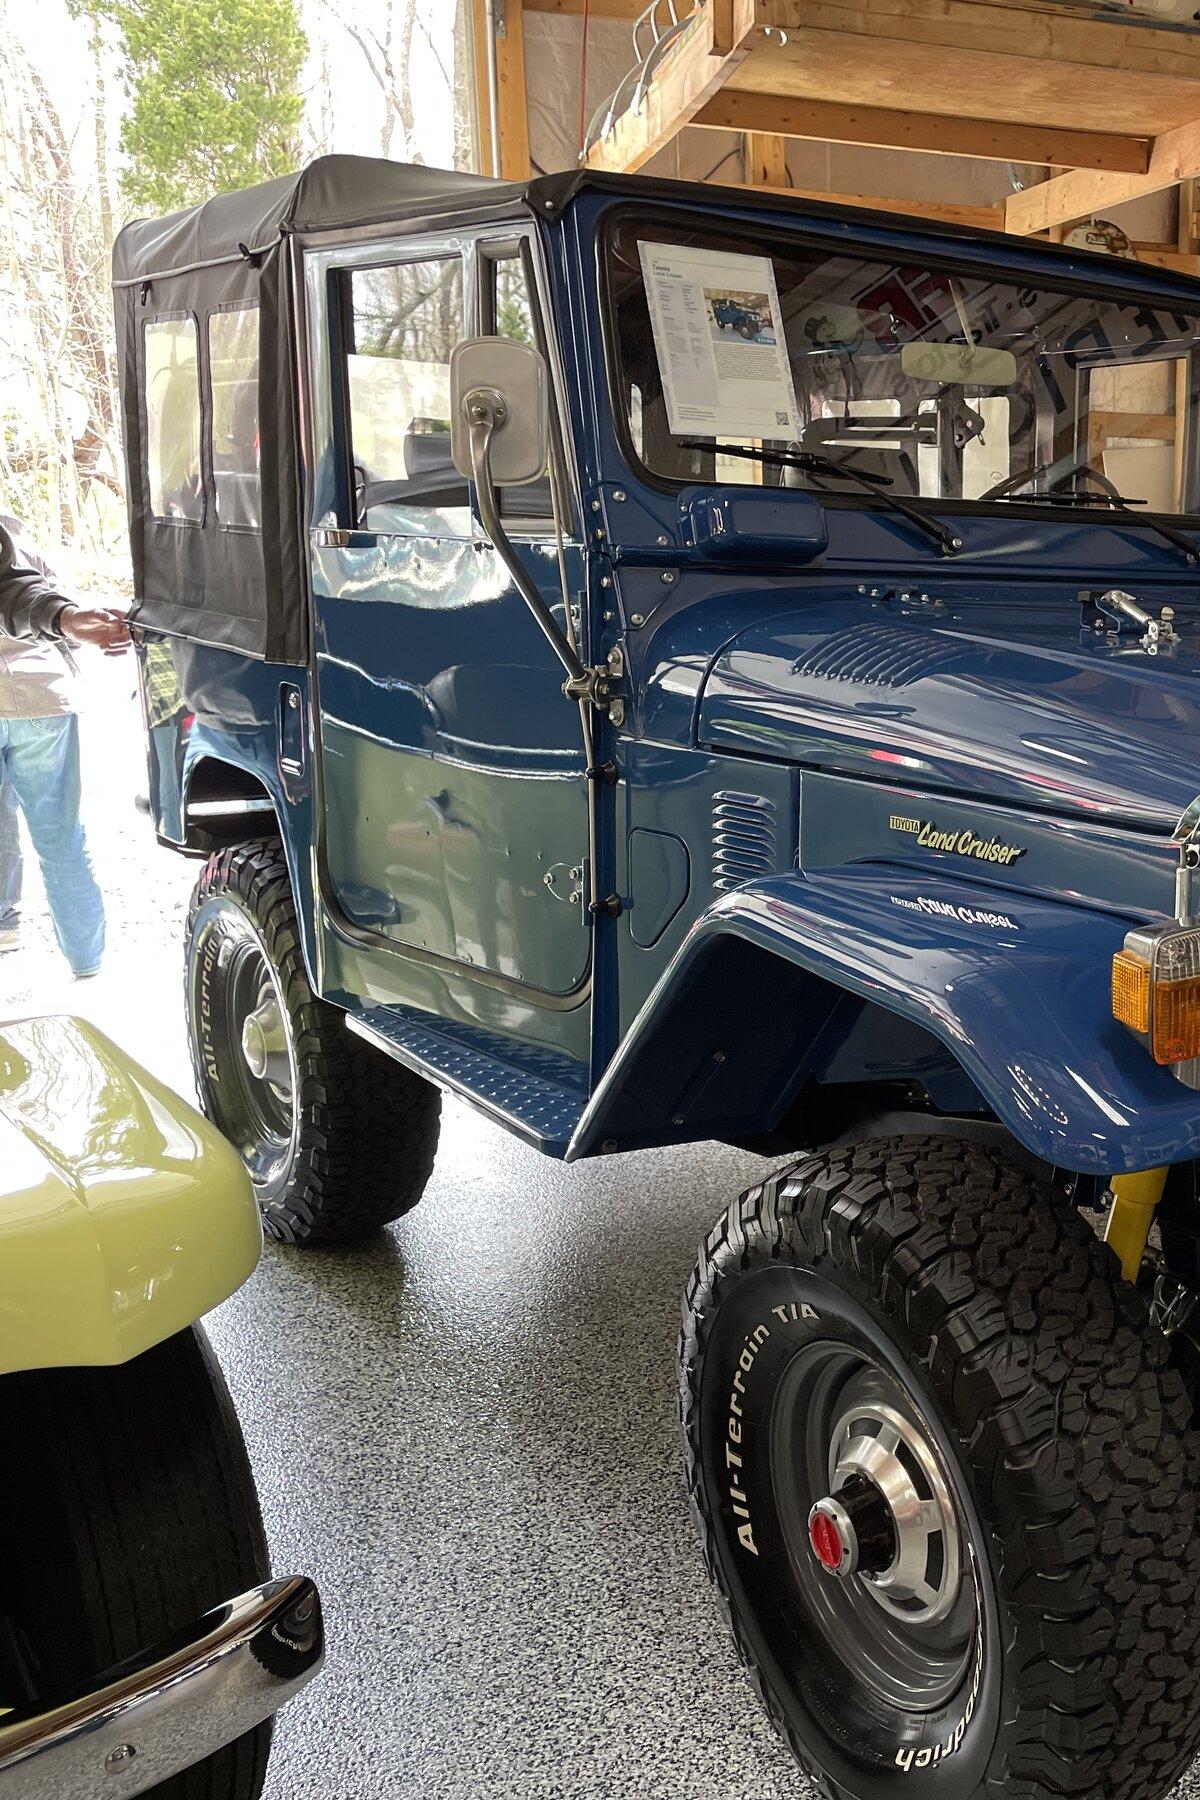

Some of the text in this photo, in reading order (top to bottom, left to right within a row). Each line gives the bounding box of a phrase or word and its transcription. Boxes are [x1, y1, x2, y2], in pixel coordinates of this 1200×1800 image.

[890, 817, 920, 832] TOYOTA
[917, 821, 1021, 865] Land Cruiser
[200, 937, 220, 1082] All-Terrain
[725, 1324, 770, 1556] All-Terrain
